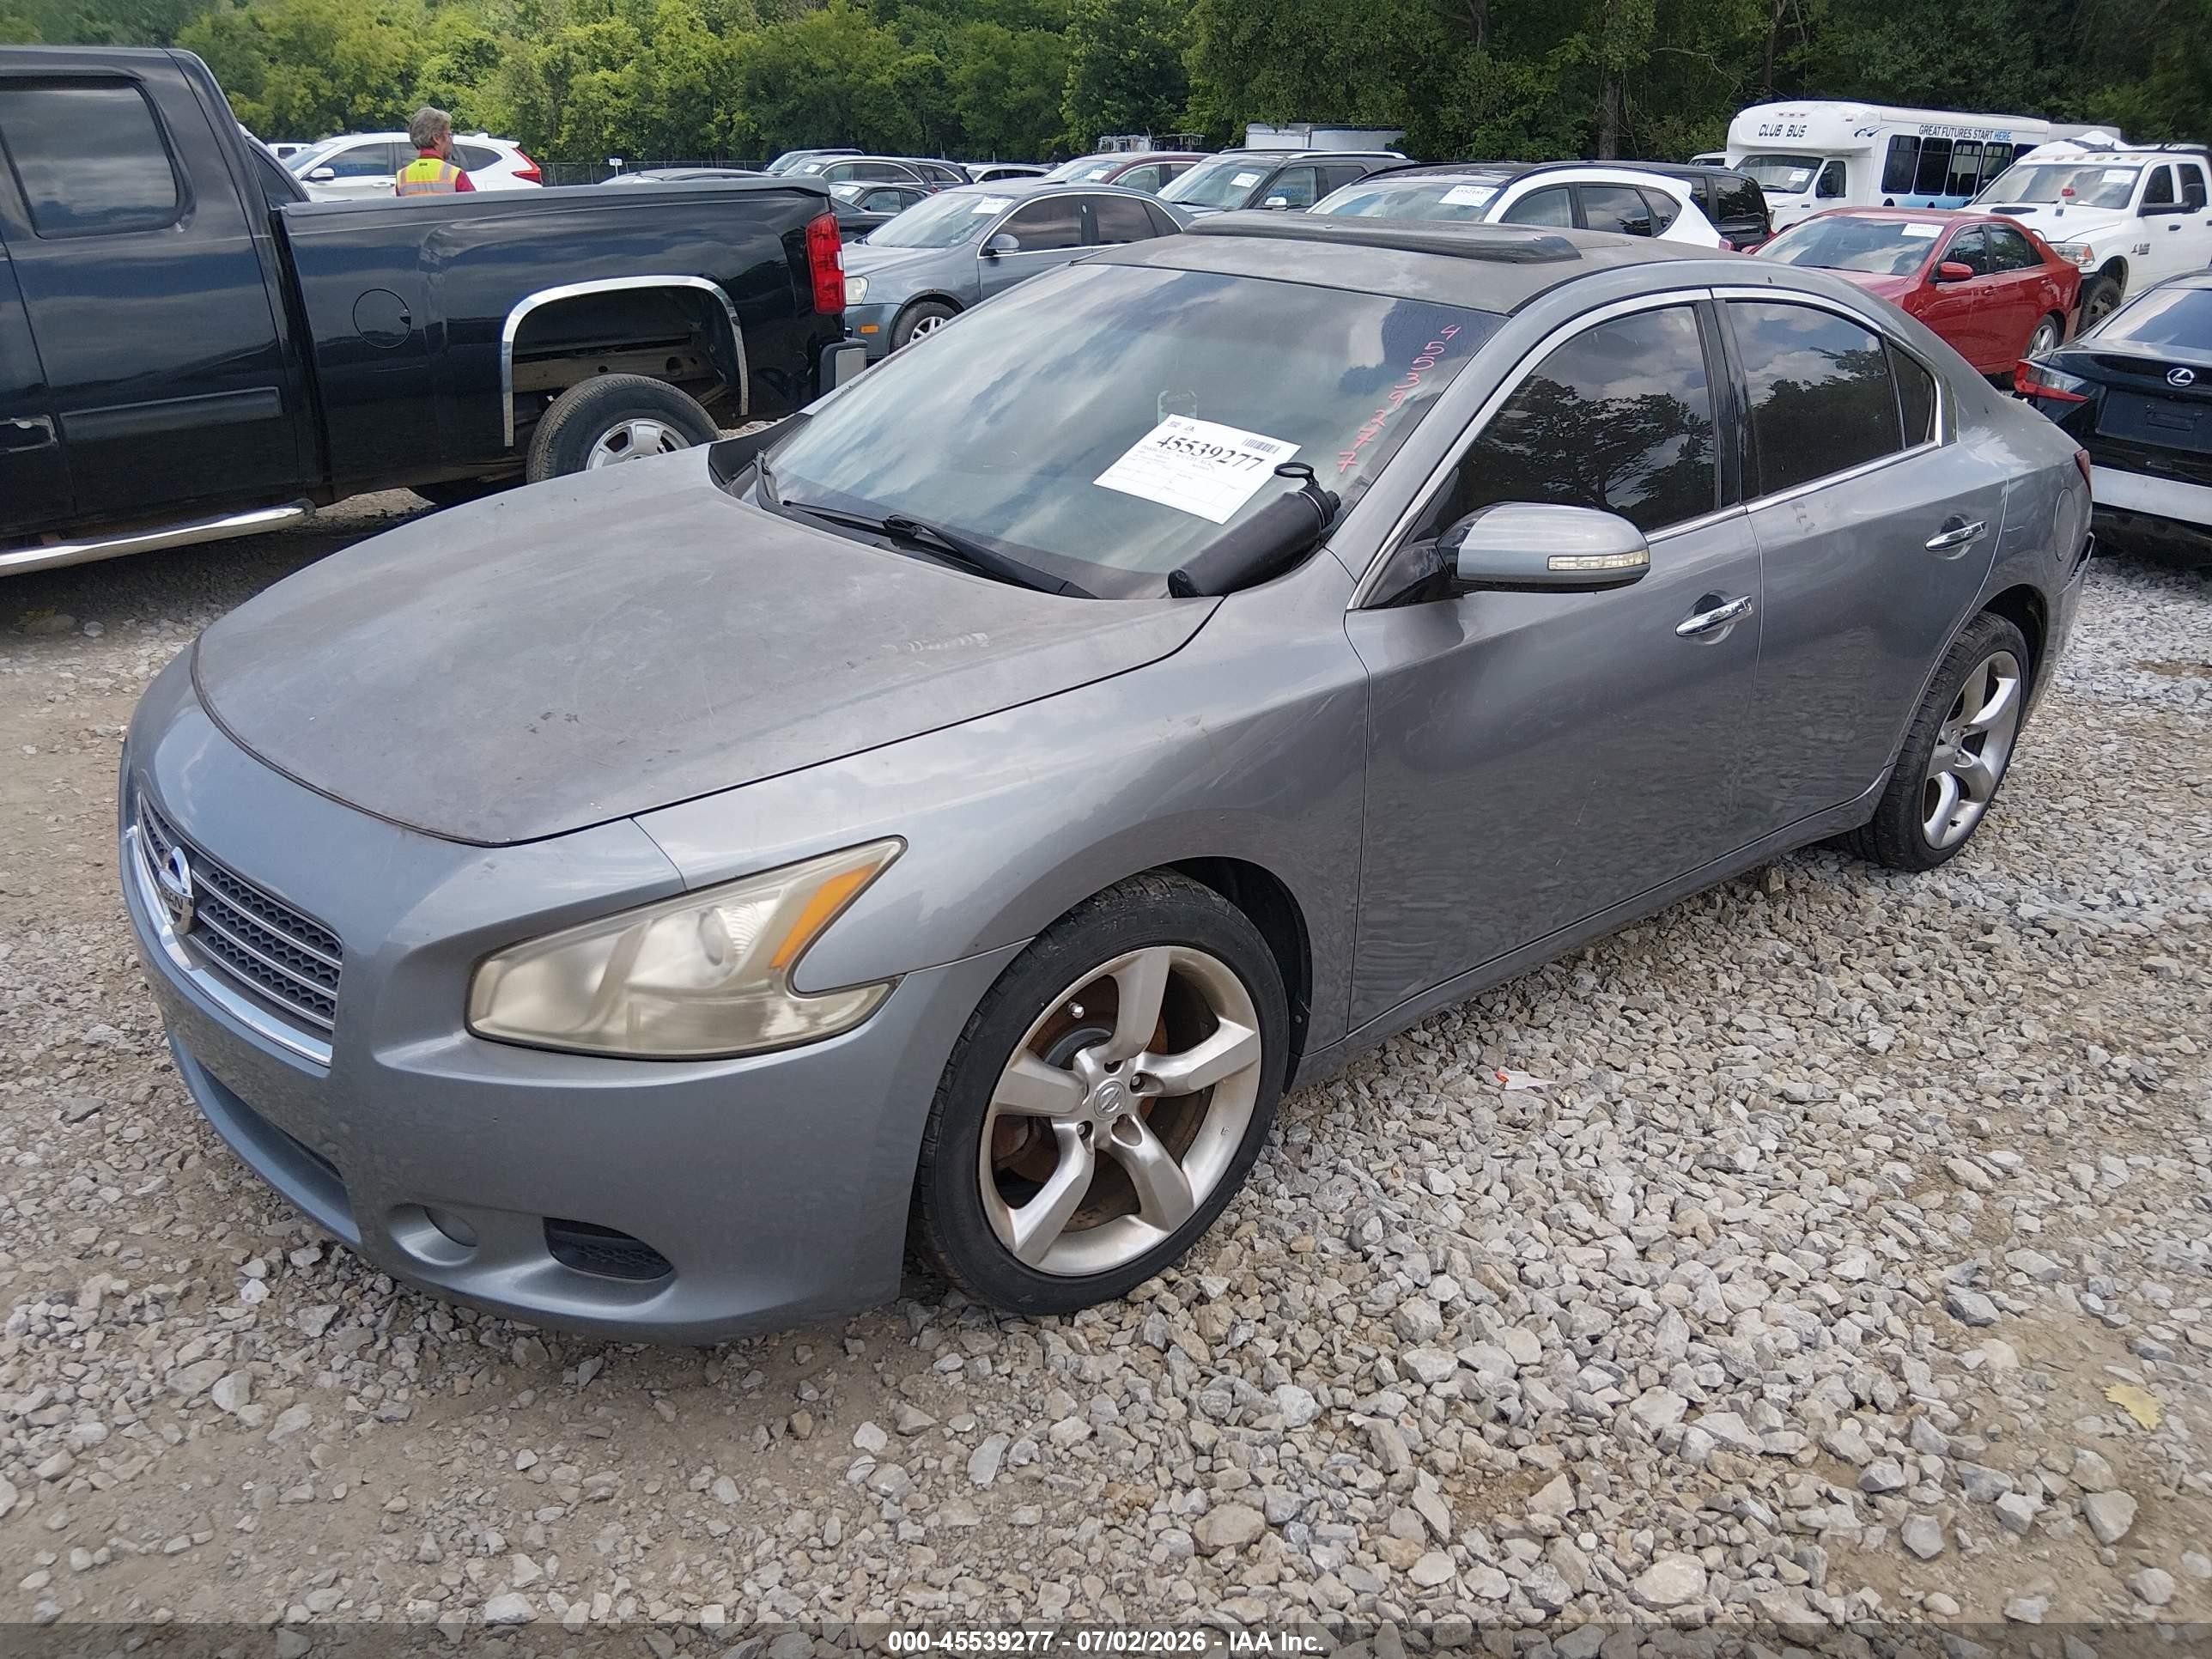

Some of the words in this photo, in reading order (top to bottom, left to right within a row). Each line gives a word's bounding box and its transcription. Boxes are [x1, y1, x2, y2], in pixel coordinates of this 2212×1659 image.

[1759, 124, 1784, 137] CLUB
[1786, 125, 1808, 137] BUS
[1918, 125, 1942, 136] GREAT
[1941, 127, 1972, 139] FUTURES
[1972, 129, 1994, 141] START
[1157, 434, 1265, 472] 45539277
